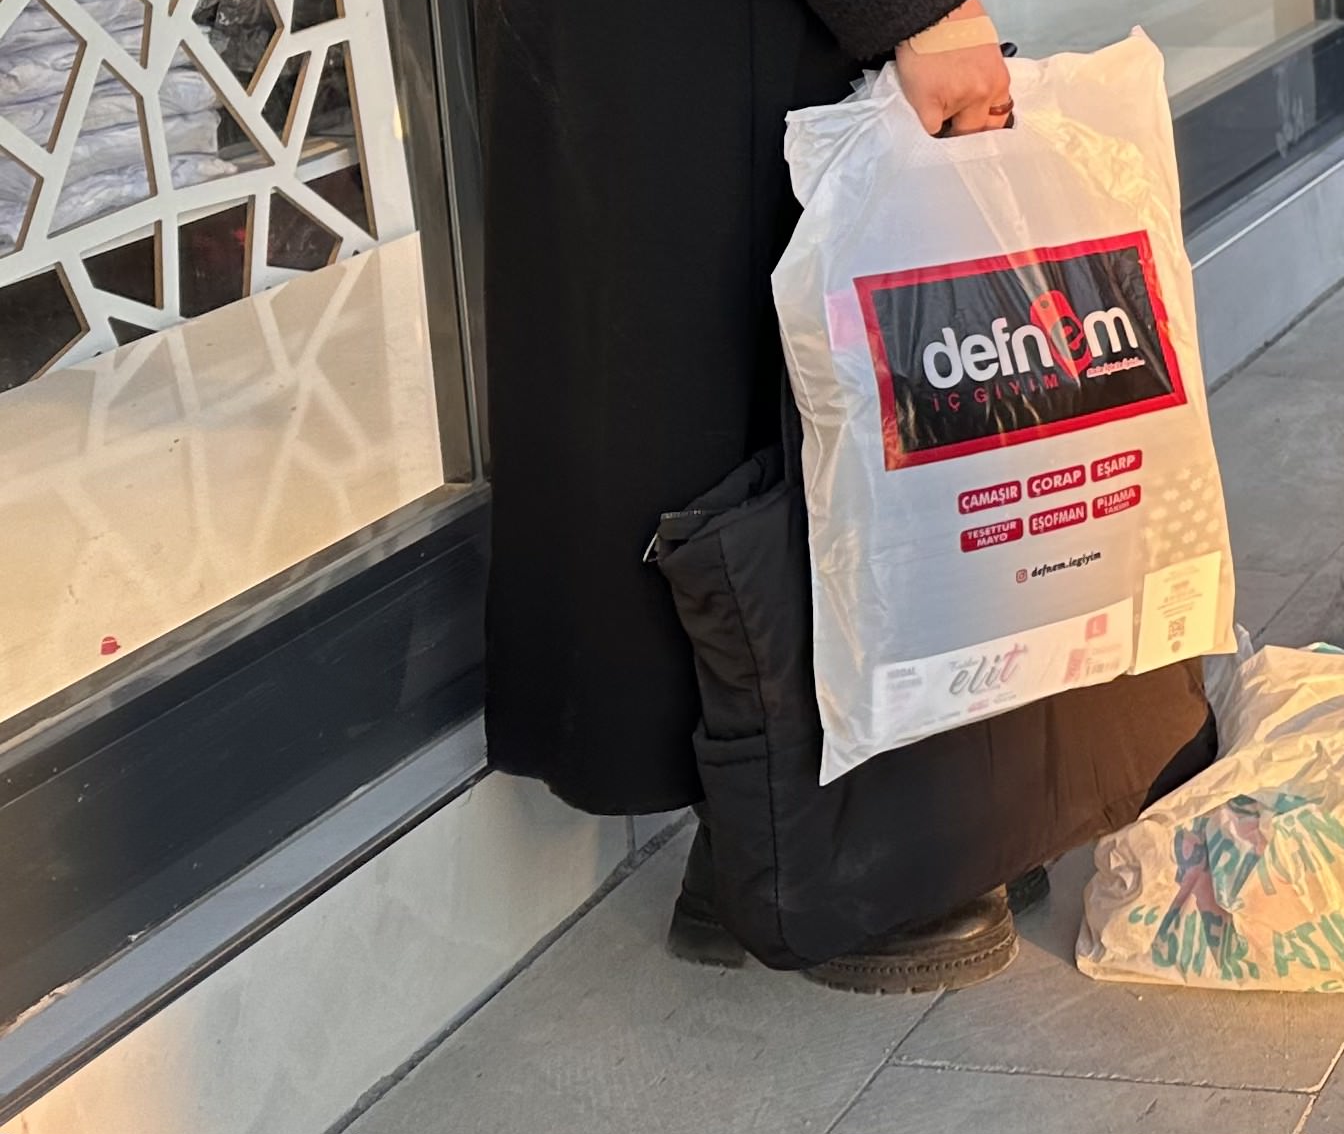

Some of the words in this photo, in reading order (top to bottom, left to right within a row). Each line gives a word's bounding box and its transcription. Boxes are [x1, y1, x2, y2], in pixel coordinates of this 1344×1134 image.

[922, 306, 1139, 390] defnem
[961, 484, 1019, 514] ÇAMAŞIR
[1031, 469, 1082, 498] ÇORAP
[1096, 454, 1136, 479] EŞARP
[976, 532, 1009, 548] MAYO
[1032, 505, 1086, 534] EŞOFMAN
